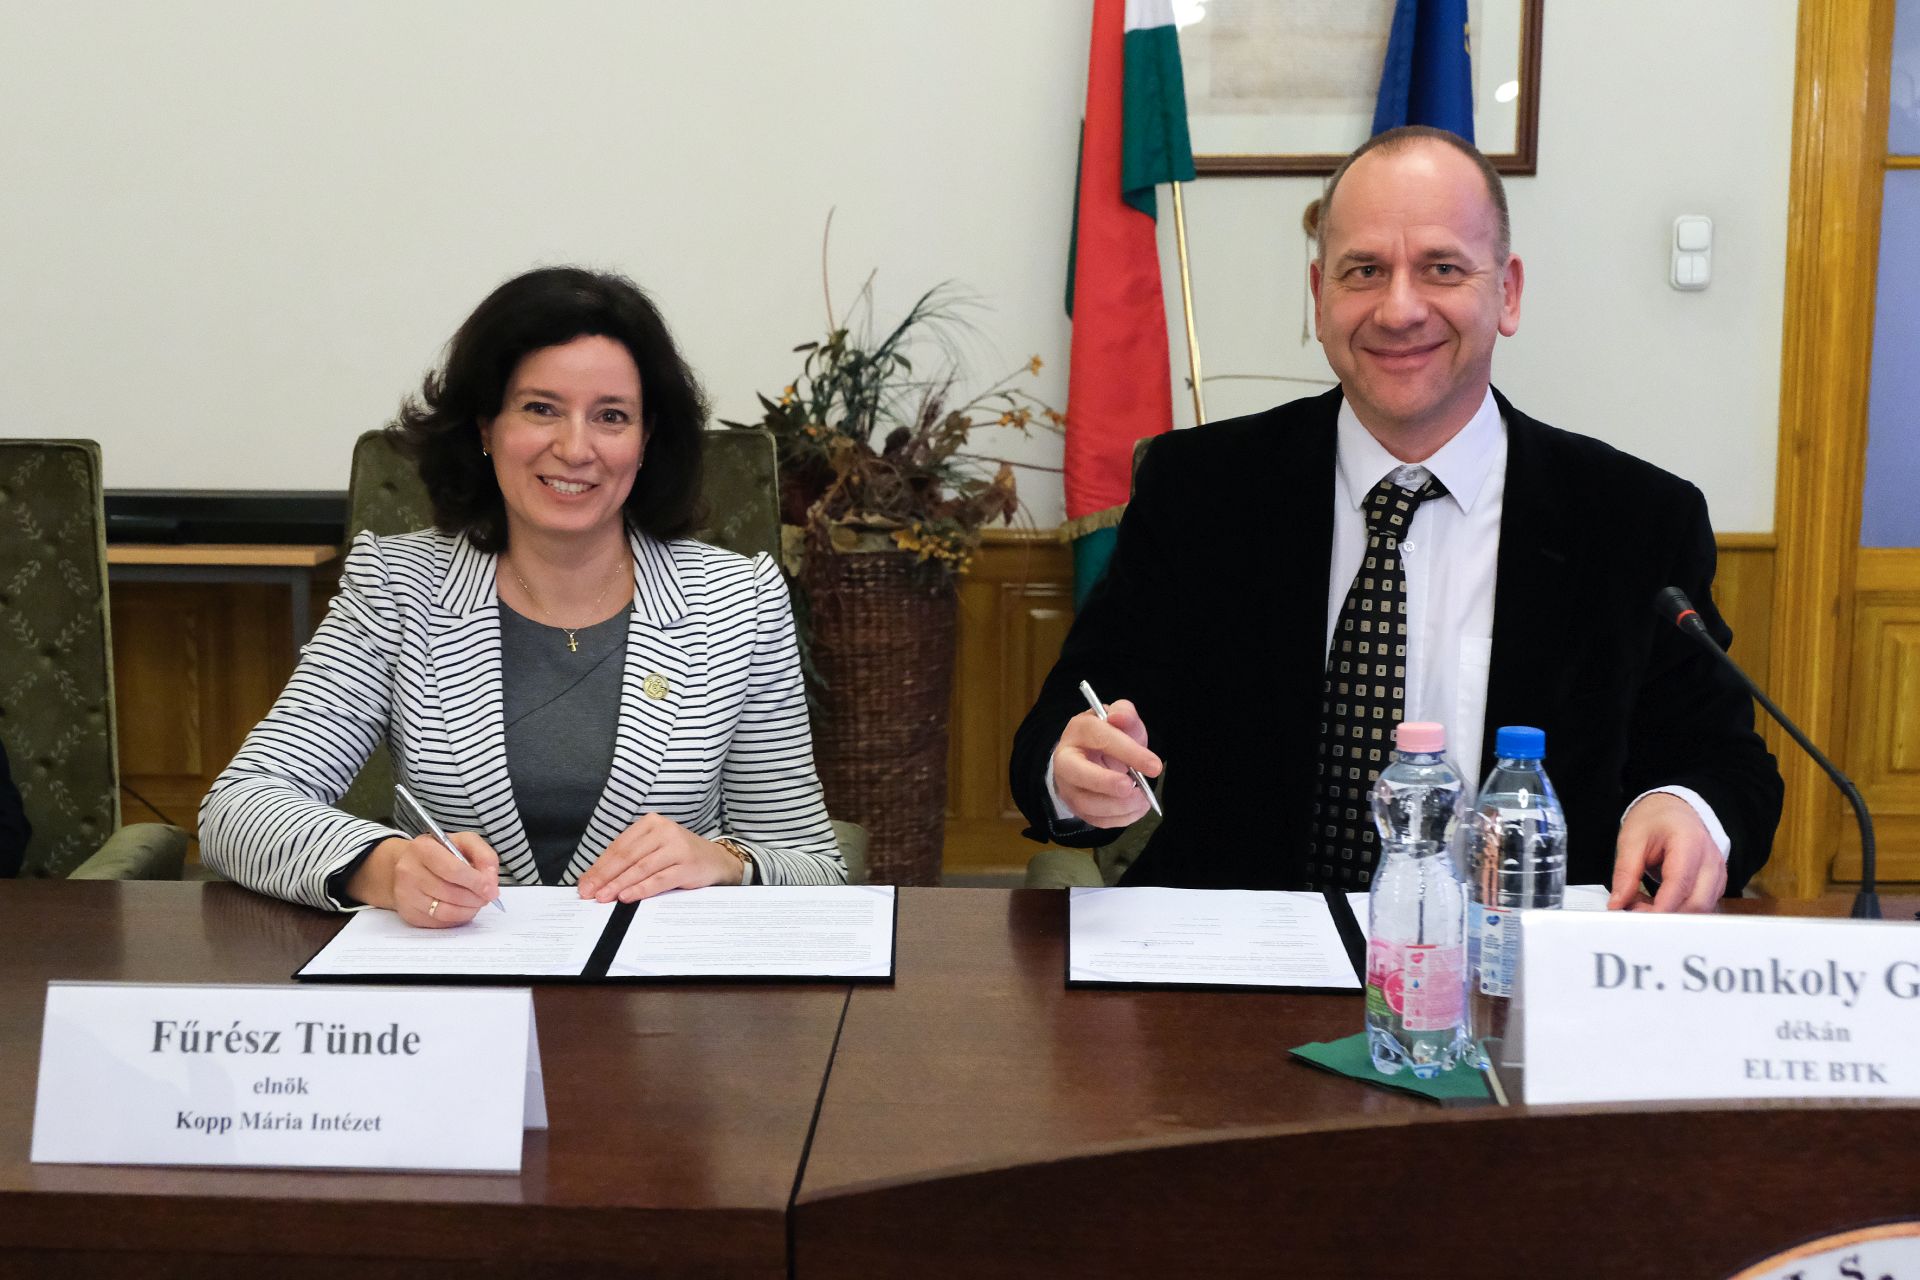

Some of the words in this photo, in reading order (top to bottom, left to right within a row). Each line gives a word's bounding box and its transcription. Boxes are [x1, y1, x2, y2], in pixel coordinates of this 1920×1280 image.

[1593, 952, 1665, 991] Dr.
[1682, 955, 1866, 1008] Sonkoly
[151, 1020, 281, 1055] Fűrész
[295, 1021, 421, 1056] Tünde
[1776, 1020, 1850, 1042] dékán
[1744, 1058, 1820, 1082] ELTE
[1829, 1061, 1888, 1084] BTK
[253, 1077, 308, 1095] elnök
[176, 1111, 232, 1135] Kopp
[240, 1112, 302, 1131] Mária
[311, 1113, 381, 1132] Intézet
